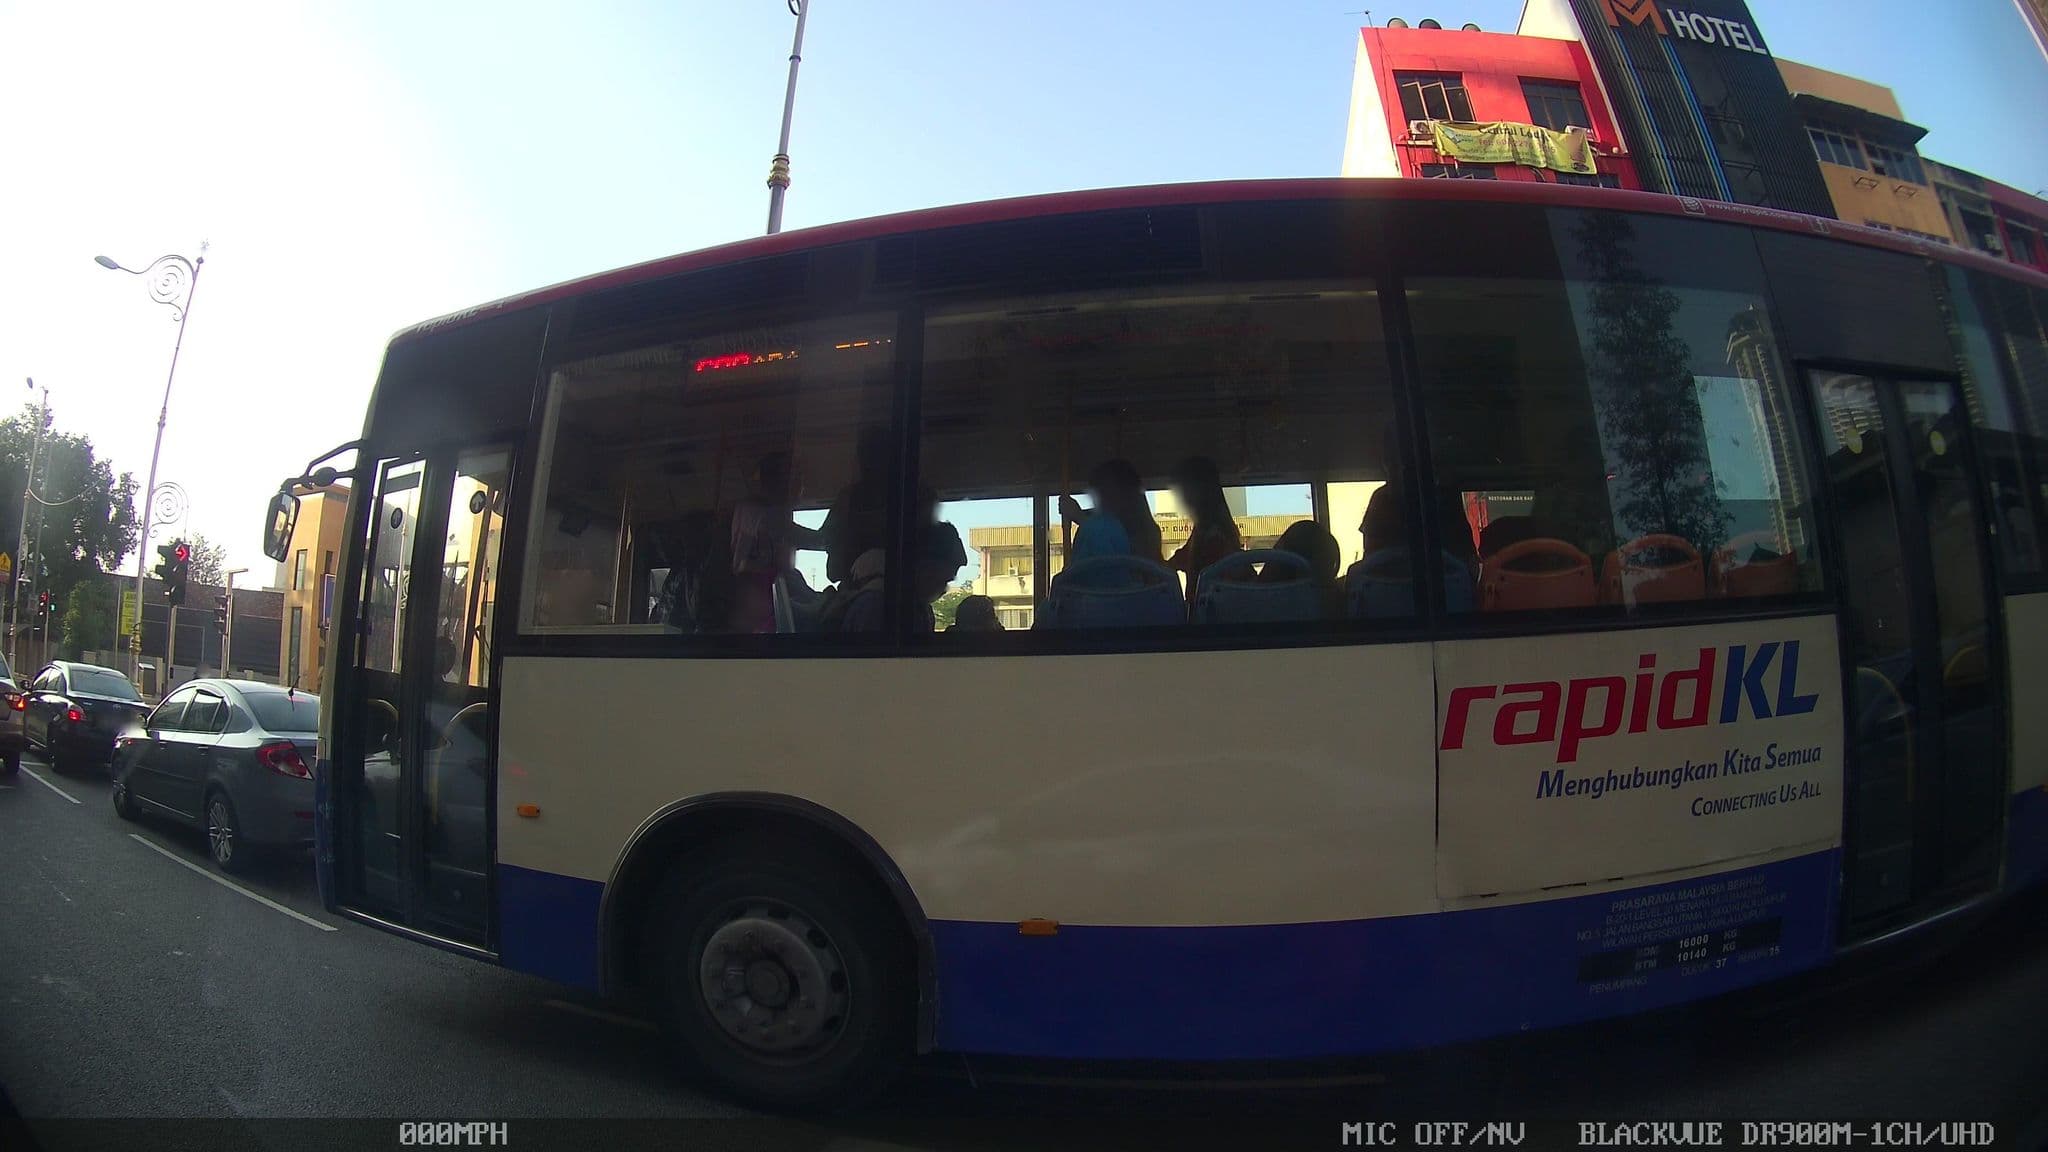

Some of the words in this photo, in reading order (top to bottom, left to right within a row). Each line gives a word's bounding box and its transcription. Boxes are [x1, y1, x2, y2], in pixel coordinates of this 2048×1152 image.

[1667, 8, 1767, 55] HOTEL
[1439, 640, 1820, 763] rapidKL
[1536, 761, 1718, 800] Menghubungkan
[1721, 750, 1761, 778] Kita
[1764, 743, 1822, 770] Semua
[1691, 789, 1777, 817] CONNECTING
[1611, 891, 1675, 912] PRASARANA
[1678, 884, 1725, 899] MALAYSIA
[1677, 947, 1707, 963] 10140
[1723, 941, 1736, 953] KG
[1679, 934, 1709, 949] 16000
[1724, 928, 1737, 941] KG
[1716, 957, 1727, 969] 37
